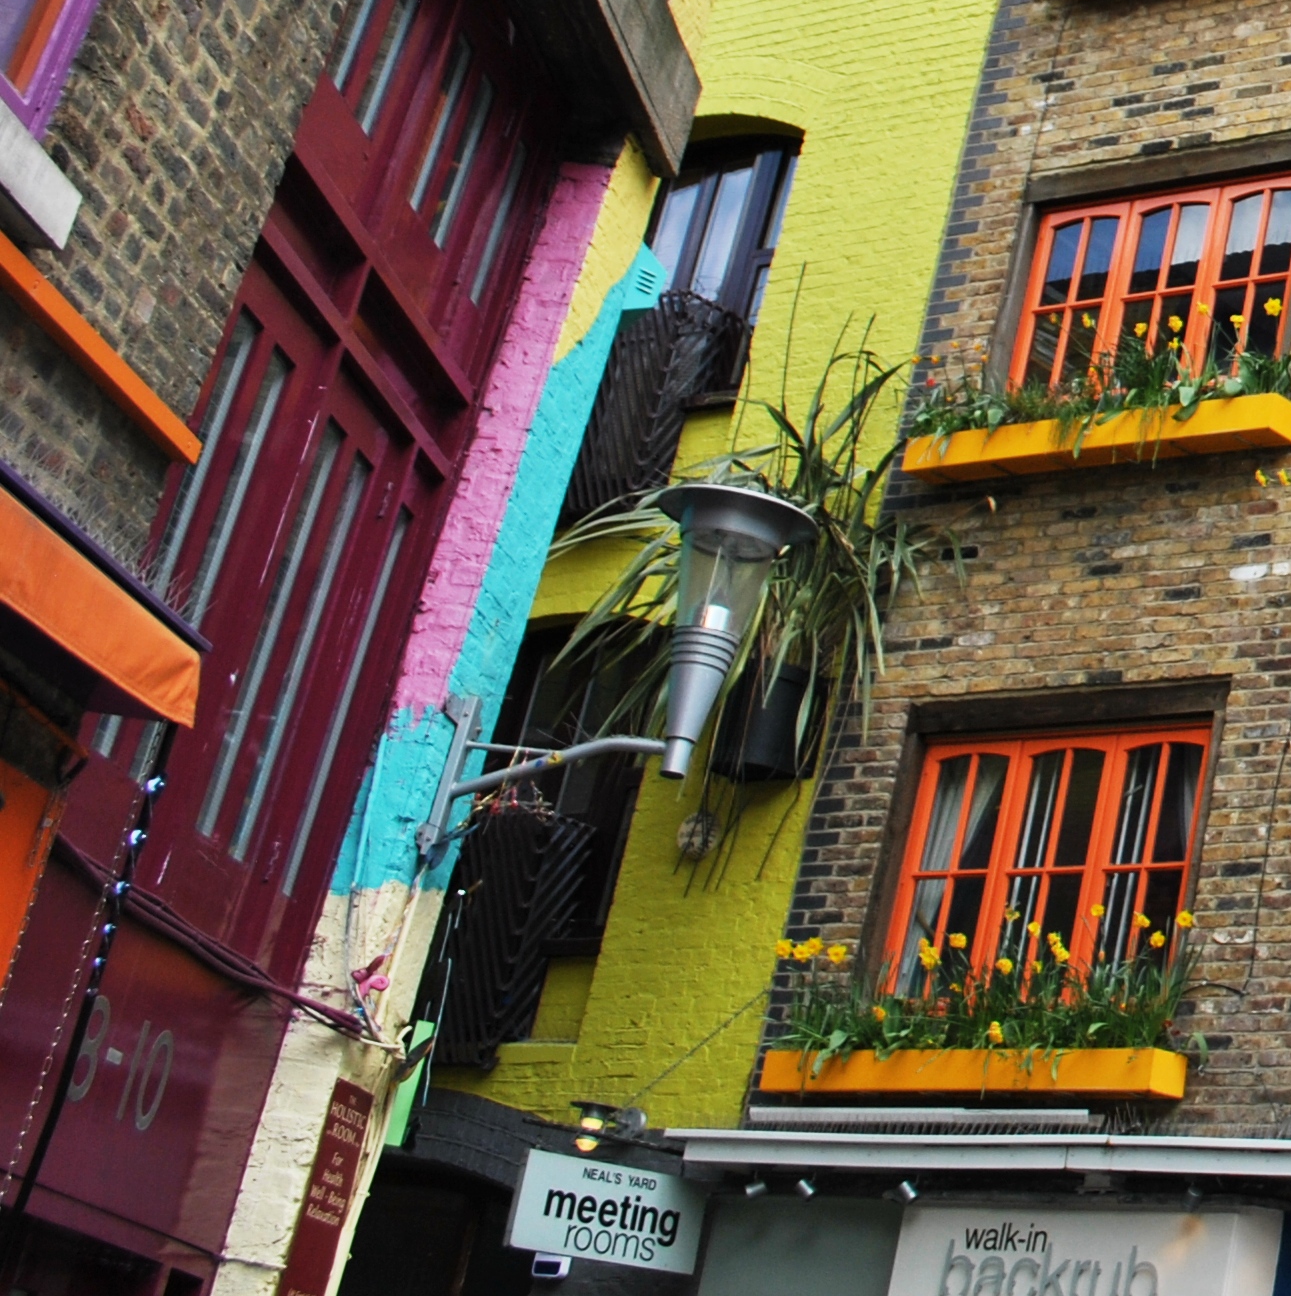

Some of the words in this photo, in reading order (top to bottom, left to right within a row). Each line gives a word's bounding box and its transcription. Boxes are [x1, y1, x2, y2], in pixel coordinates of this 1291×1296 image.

[331, 1101, 367, 1130] HOLISTIC
[322, 1168, 344, 1187] Health
[583, 1167, 622, 1185] NEAL'S
[629, 1175, 657, 1191] YARD
[306, 1203, 340, 1226] Relaxation
[543, 1188, 681, 1247] meeting
[564, 1224, 656, 1262] rooms
[965, 1222, 1048, 1253] walk-in
[938, 1238, 1158, 1296] backrub
